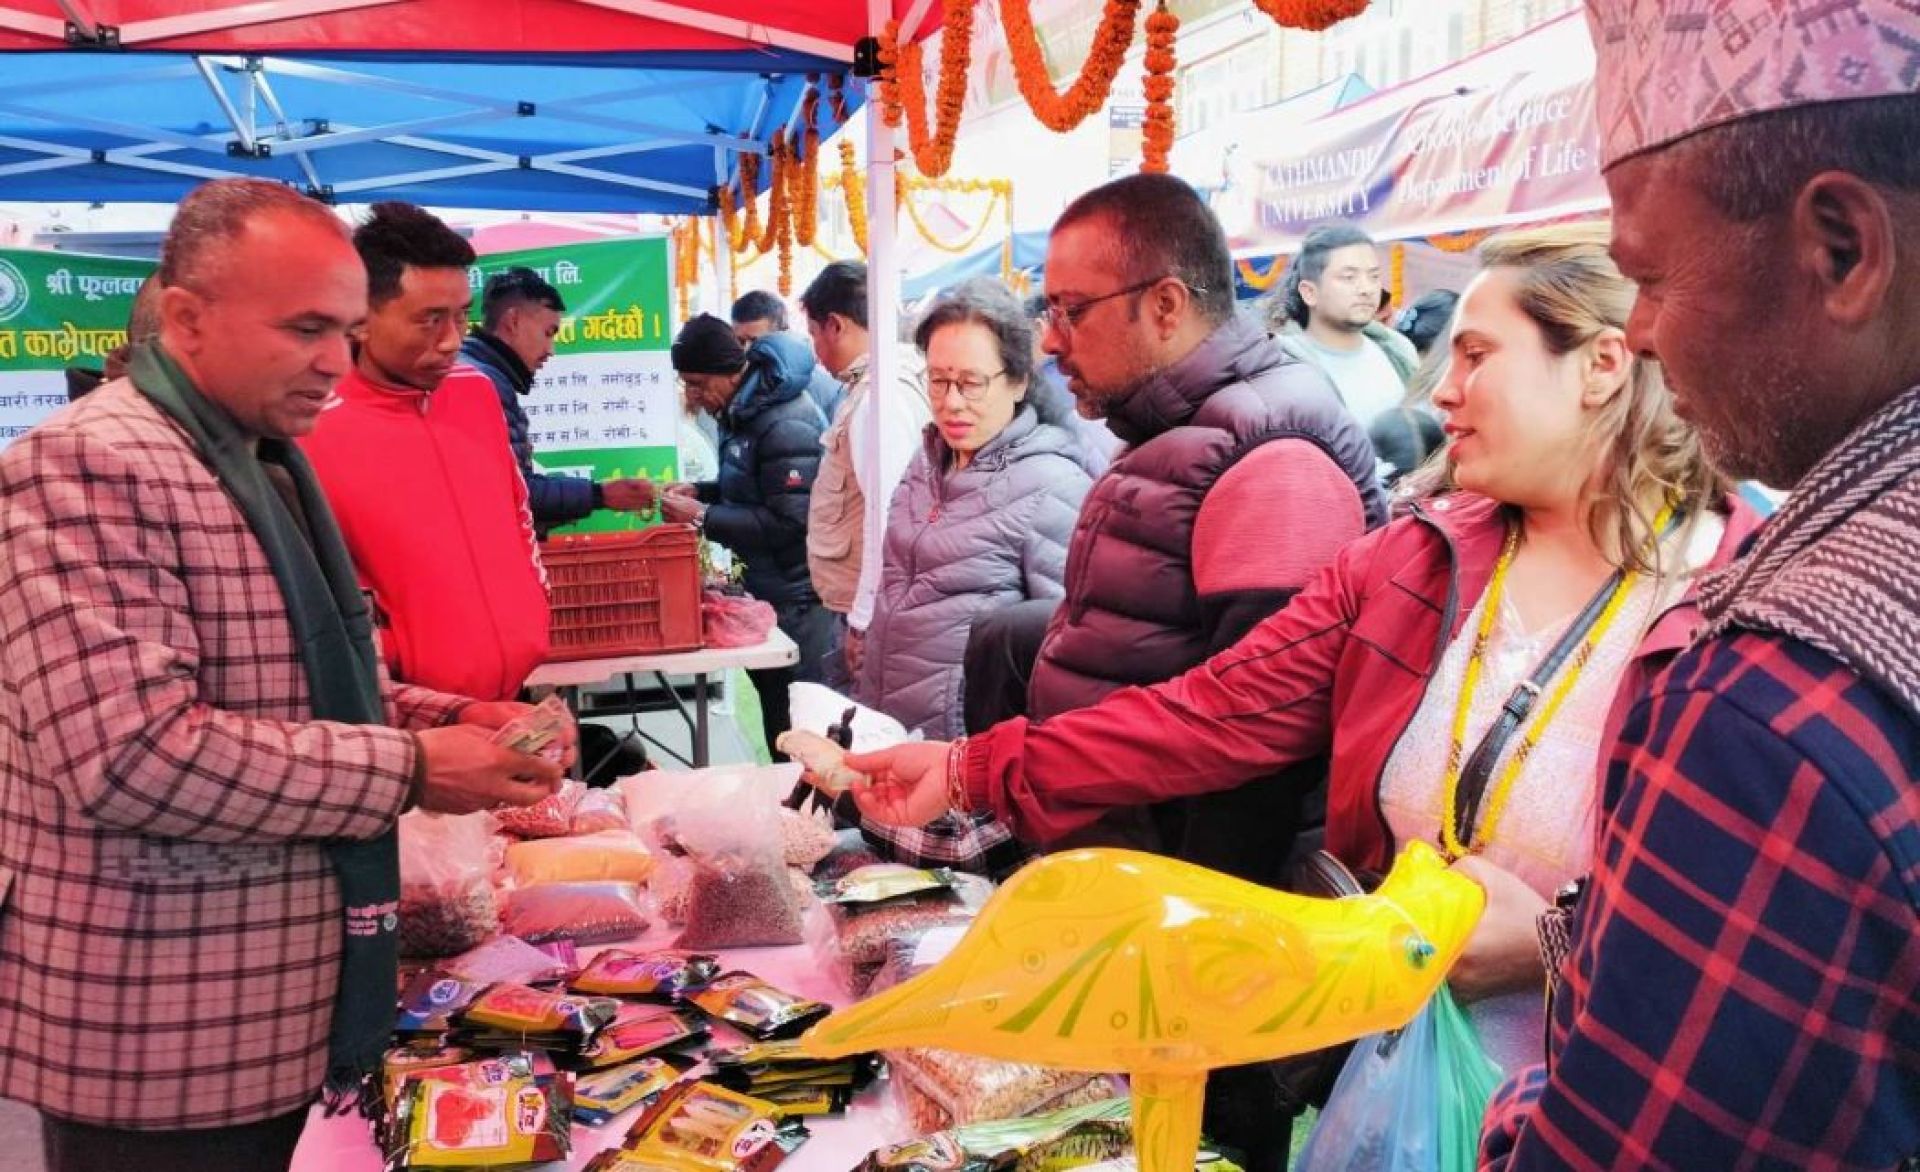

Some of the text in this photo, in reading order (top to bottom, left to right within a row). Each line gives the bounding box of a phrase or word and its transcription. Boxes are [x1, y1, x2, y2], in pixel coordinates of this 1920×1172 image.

[1511, 145, 1537, 180] of
[1542, 140, 1586, 177] Life
[1262, 184, 1371, 228] UNIVERSITY
[45, 268, 73, 296] श्री
